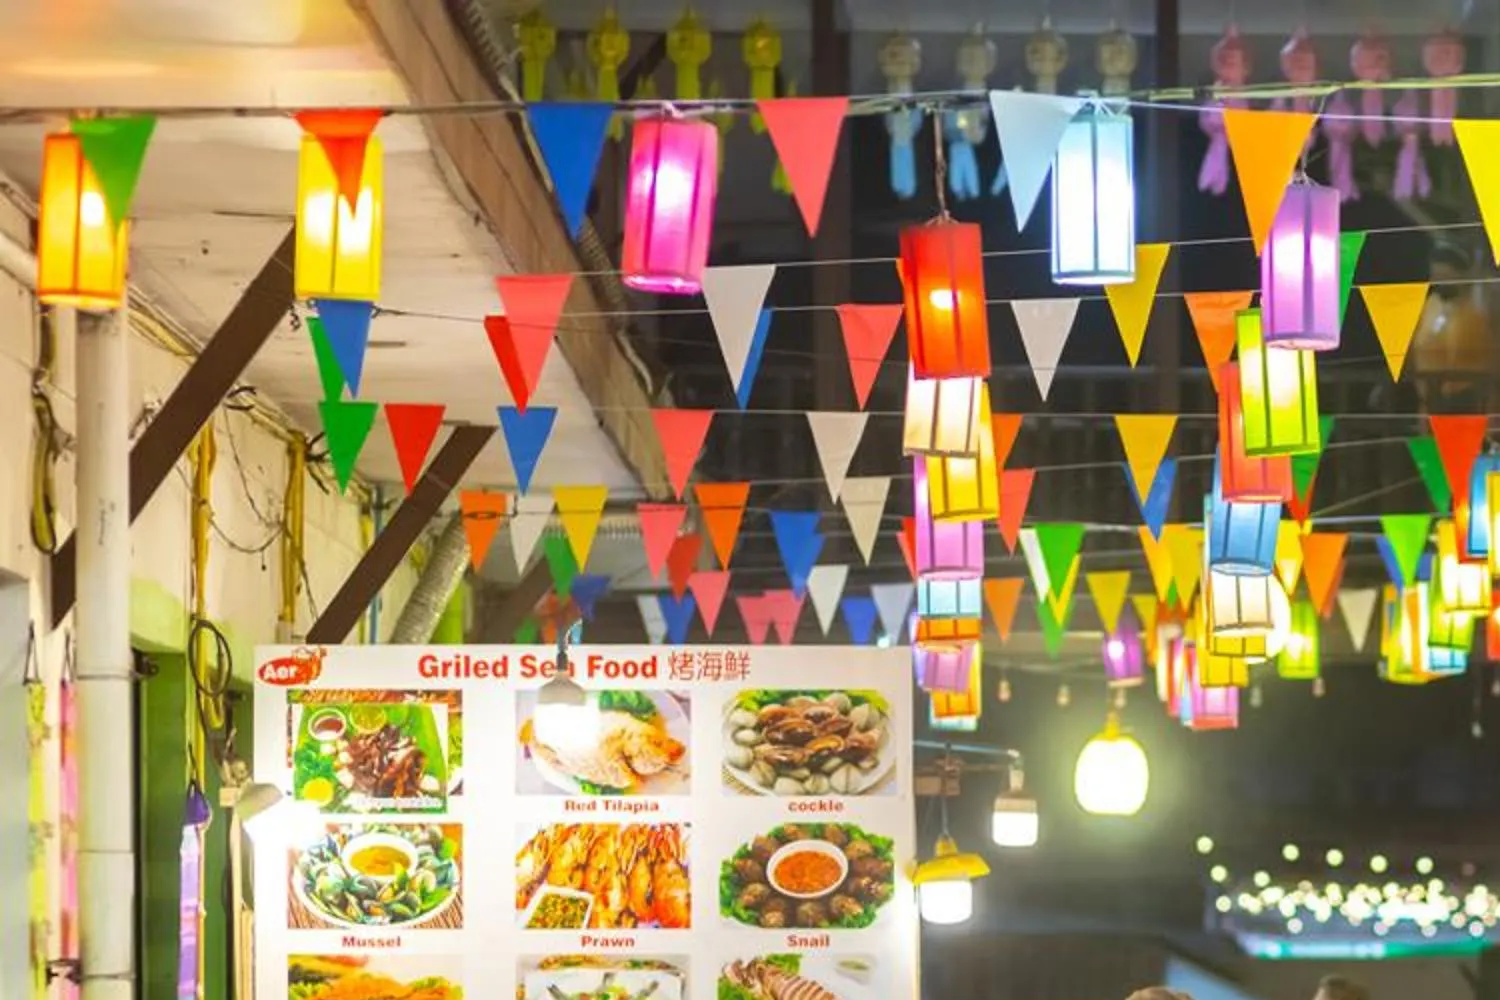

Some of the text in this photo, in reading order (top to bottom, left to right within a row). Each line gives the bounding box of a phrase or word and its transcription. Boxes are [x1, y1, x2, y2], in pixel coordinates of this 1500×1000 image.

[418, 654, 509, 678] Griled
[587, 654, 658, 678] Food
[667, 650, 751, 681] 烤海鮮
[564, 799, 660, 813] Red Tilapia
[788, 799, 845, 812] cockle
[341, 935, 401, 948] Mussel
[580, 935, 635, 947] Prawn
[787, 934, 830, 948] Snail
